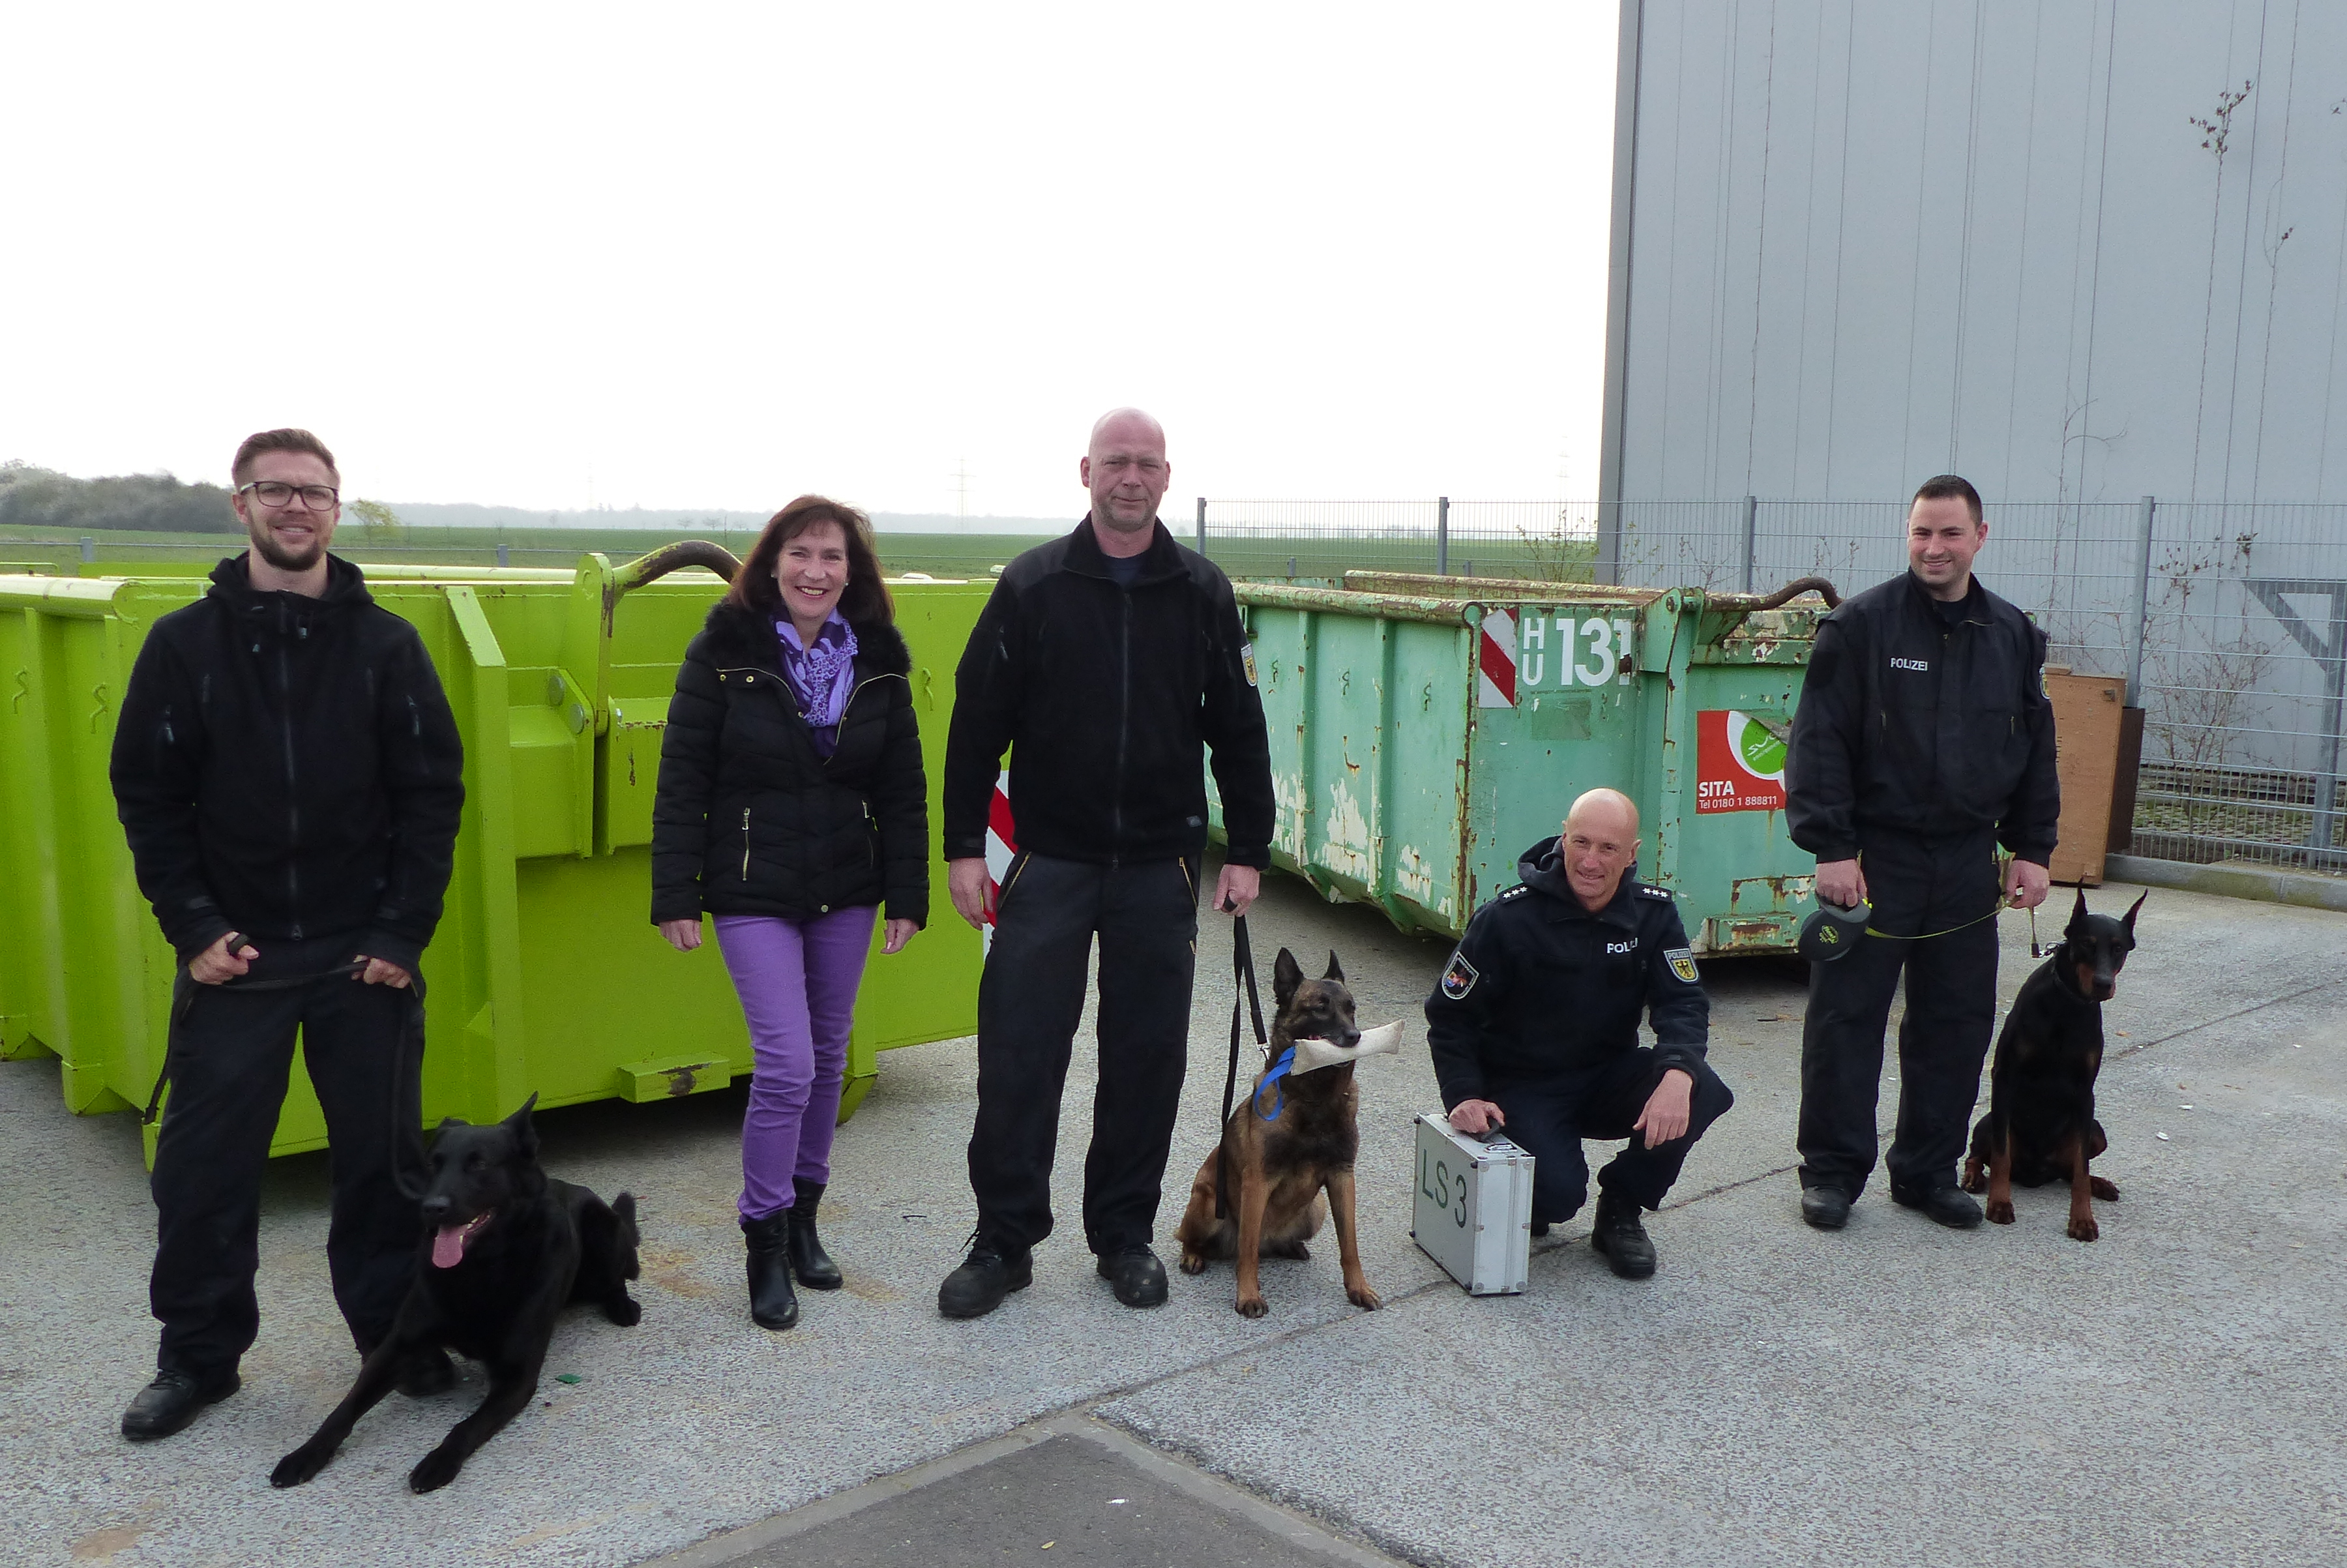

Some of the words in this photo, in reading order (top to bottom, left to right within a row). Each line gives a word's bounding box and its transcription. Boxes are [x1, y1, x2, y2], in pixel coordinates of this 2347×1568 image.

[1556, 617, 1632, 687] 131
[1891, 658, 1928, 672] POLIZEI
[1698, 780, 1735, 797] SITA
[1698, 799, 1711, 809] Tel
[1712, 797, 1734, 808] 0180
[1737, 797, 1742, 806] 1
[1745, 795, 1777, 806] 888811
